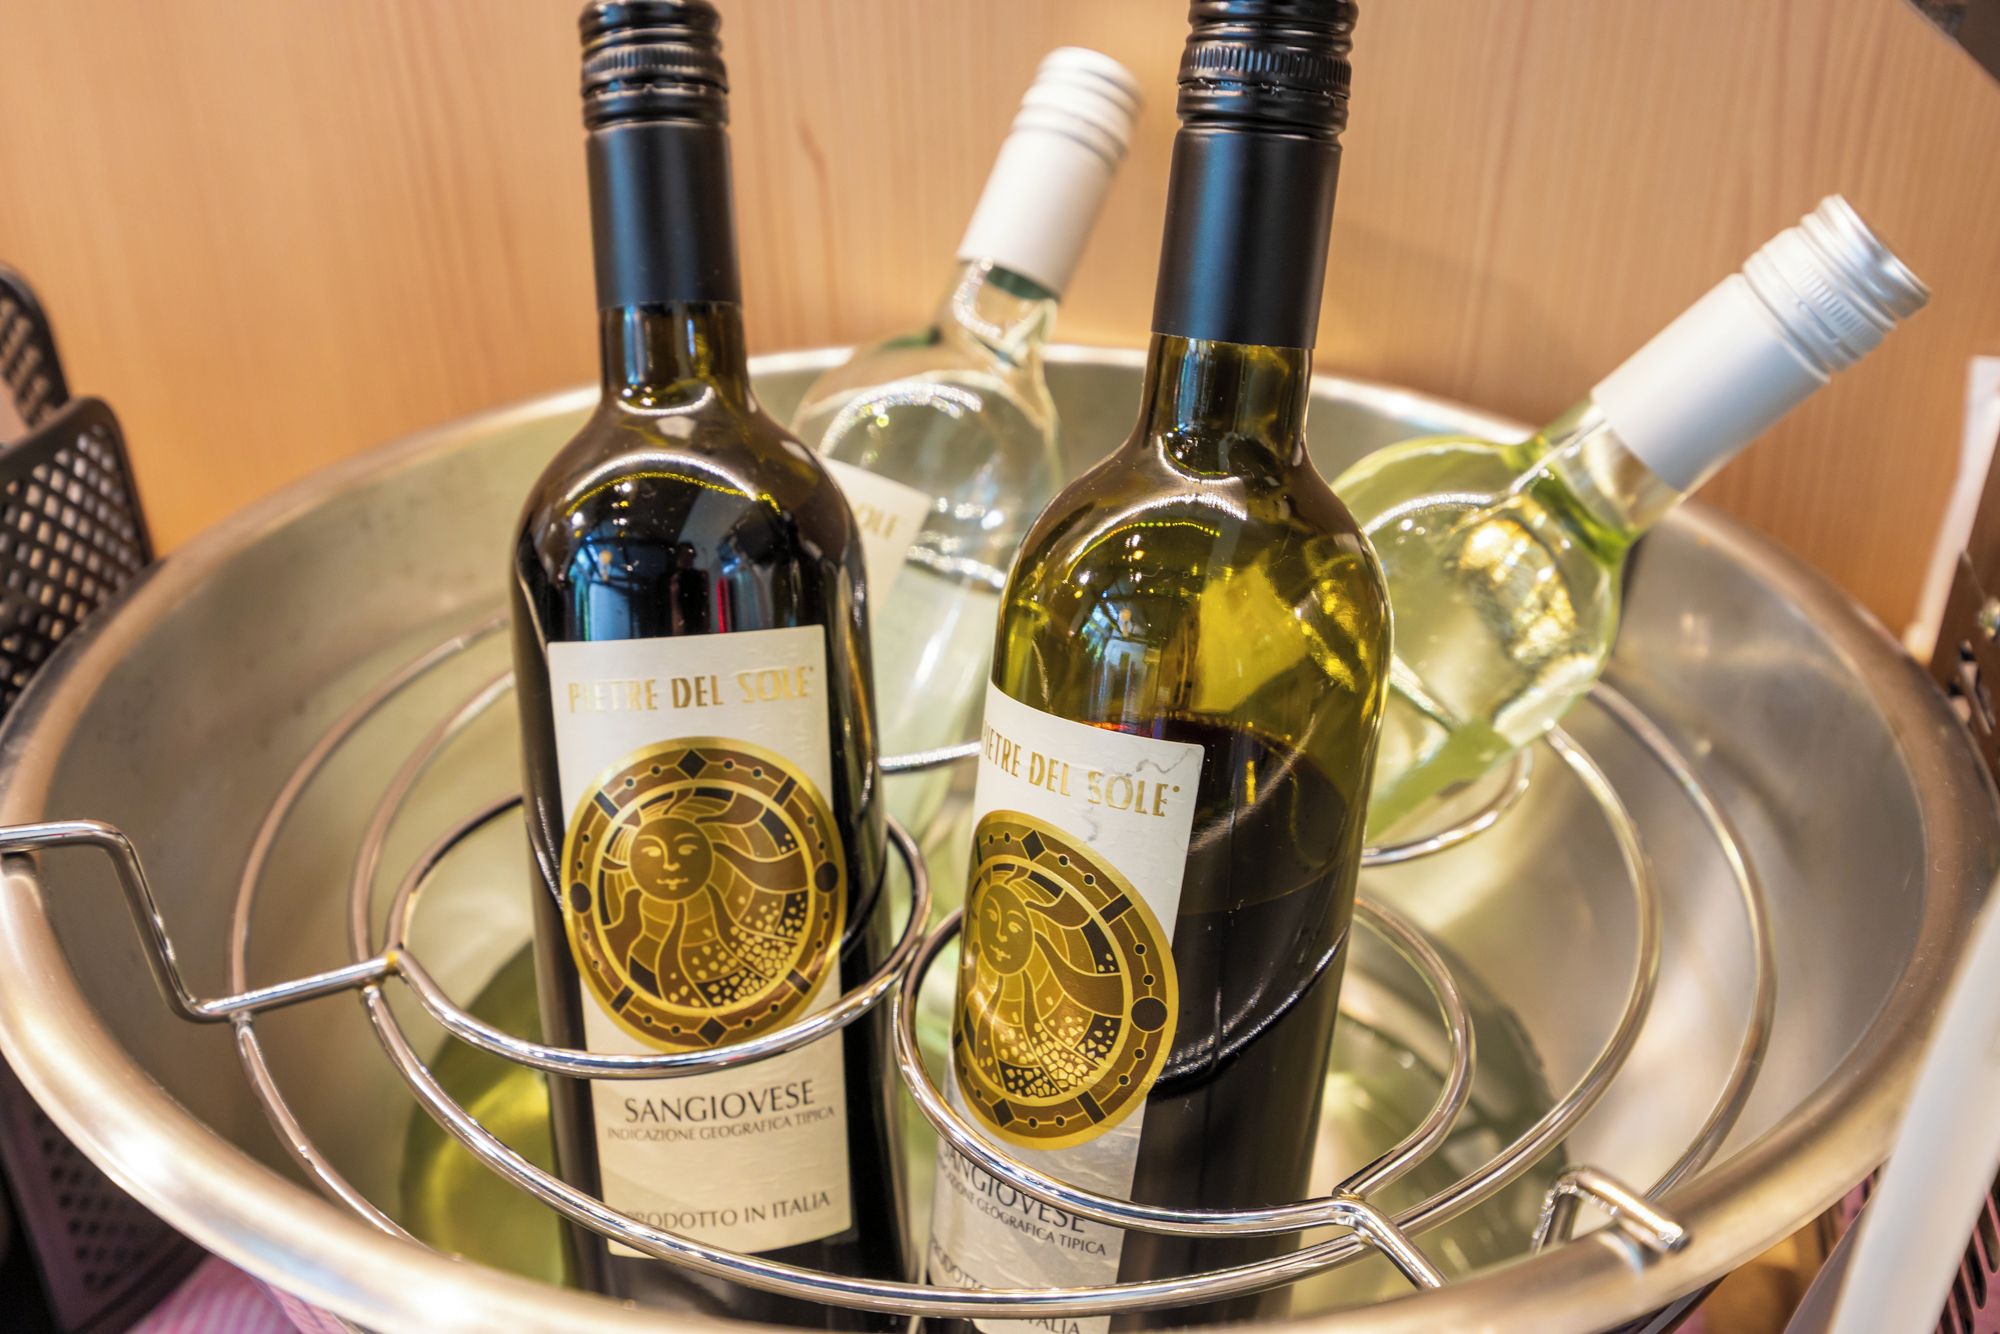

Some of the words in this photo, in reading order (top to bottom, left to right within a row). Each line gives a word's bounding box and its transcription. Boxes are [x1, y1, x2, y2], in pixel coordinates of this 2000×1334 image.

[568, 679, 658, 713] PIETRE
[671, 675, 724, 708] DEL
[1029, 752, 1071, 797] DEL
[625, 1079, 816, 1124] SANGIOVESE
[607, 1125, 697, 1142] INDICAZIONE
[700, 1118, 793, 1141] GEOGRAFICA
[795, 1106, 836, 1127] TIPICA
[744, 1204, 768, 1225] IN
[772, 1190, 832, 1220] ITALIA
[976, 1197, 1056, 1244] GEOGRAFICA
[1059, 1233, 1107, 1257] TIPICA
